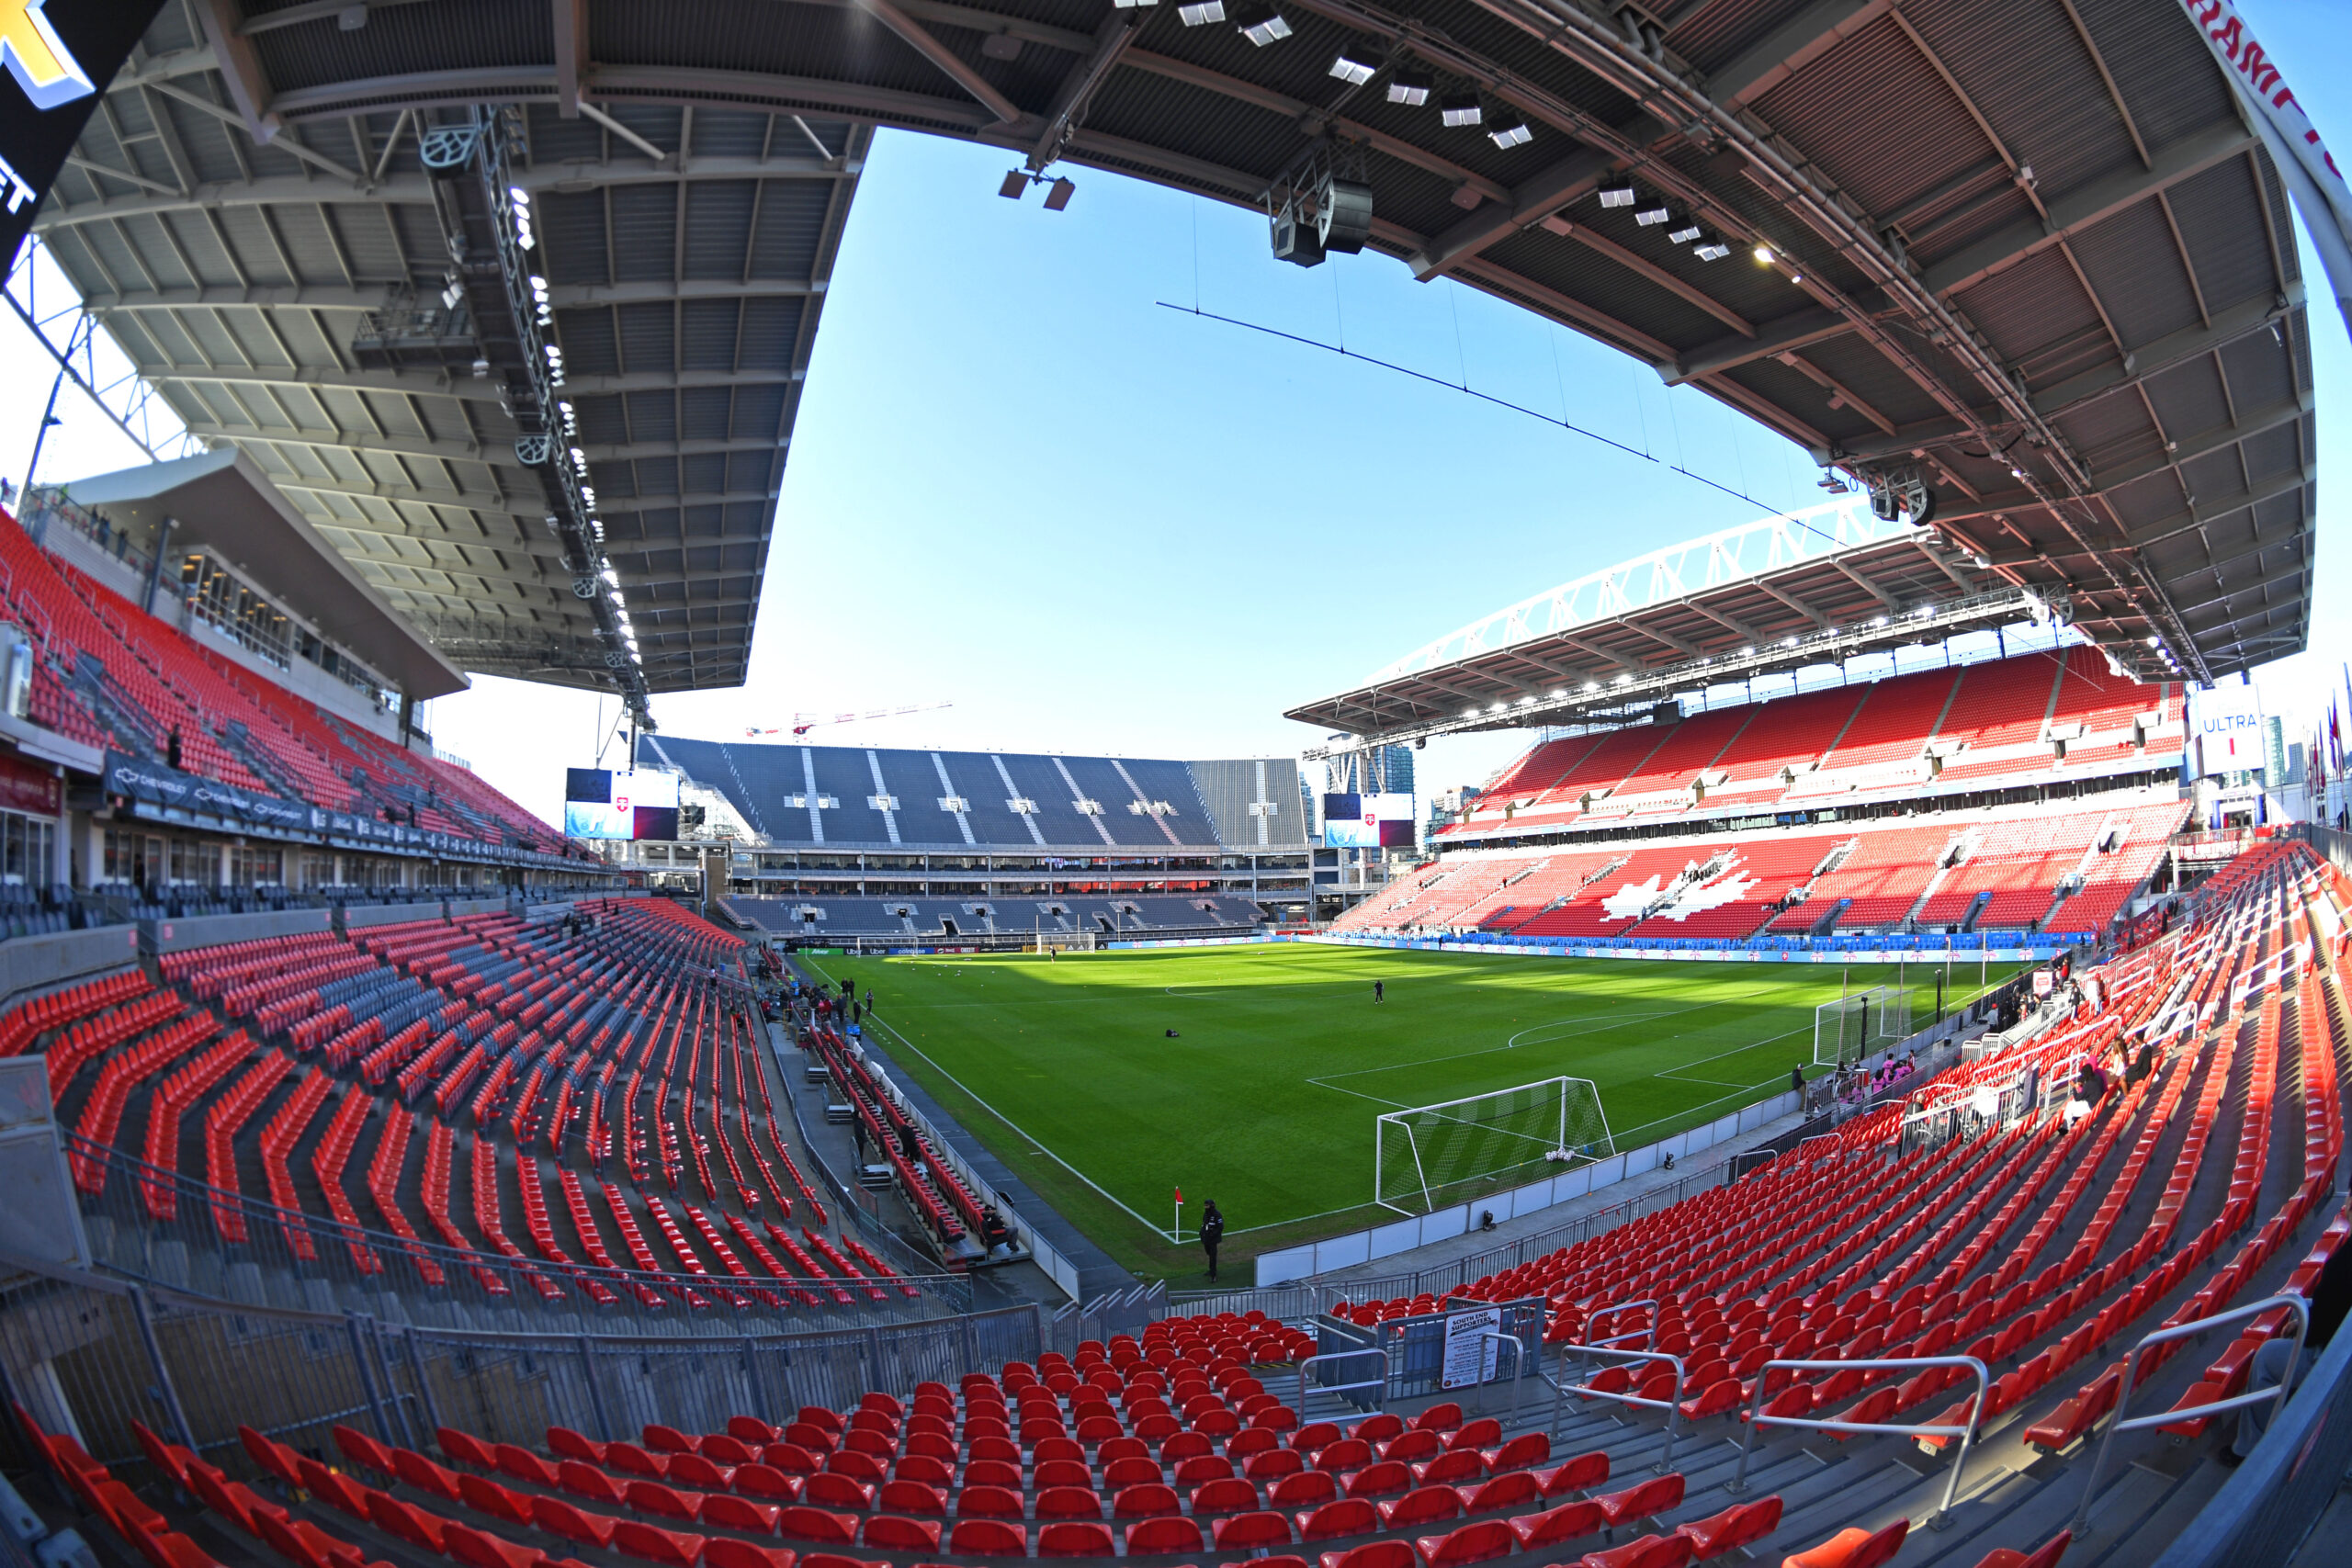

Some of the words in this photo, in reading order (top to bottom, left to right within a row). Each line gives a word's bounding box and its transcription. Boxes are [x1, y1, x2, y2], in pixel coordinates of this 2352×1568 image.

[2203, 713, 2257, 734] ULTRA
[139, 775, 187, 795] CHEVROLET
[1451, 1316, 1492, 1332] SUPPORTERS
[1453, 1316, 1475, 1325] SOUTH
[1476, 1312, 1488, 1320] END
